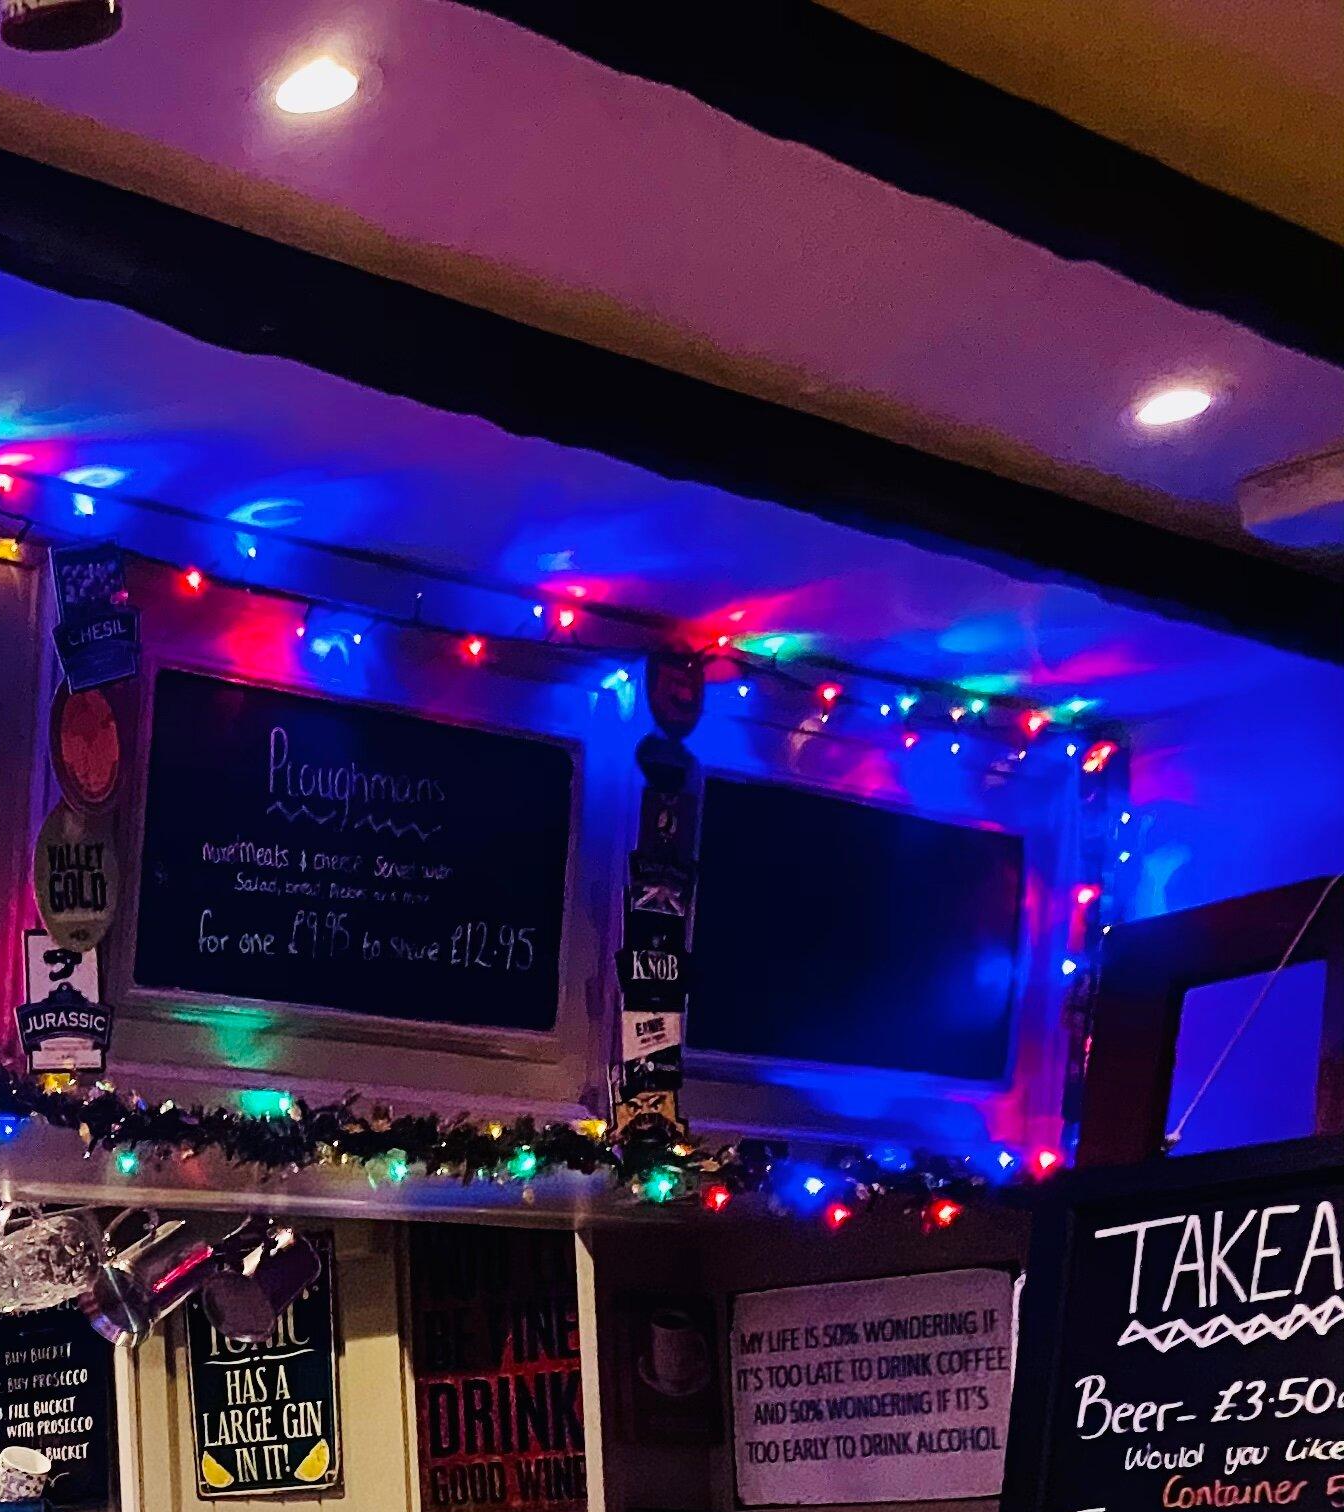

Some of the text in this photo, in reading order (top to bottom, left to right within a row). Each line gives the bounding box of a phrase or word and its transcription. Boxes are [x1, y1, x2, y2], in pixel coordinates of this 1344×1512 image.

[68, 617, 129, 646] CHESIL
[47, 842, 104, 872] VALLEY
[49, 870, 108, 913] GOLD
[238, 920, 537, 971] one to £12.95
[631, 949, 679, 981] KNOB
[24, 1010, 107, 1034] JURASSIC
[740, 1308, 999, 1355] MY LIFE IS 50% WONDERING IF
[5, 1341, 72, 1366] BUY BUCKET
[736, 1345, 1011, 1393] IT'S TOO LATE TO DRINK COFFEE
[7, 1368, 88, 1393] BUY PROSECCO
[225, 1364, 291, 1406] HAS A
[8, 1395, 76, 1421] FILL BUCKET
[427, 1371, 587, 1455] DRINK
[754, 1384, 989, 1426] AND 50% WONDERING IF IT'S
[6, 1416, 94, 1439] WITH PROSECCO
[202, 1400, 323, 1448] LARGE GIN
[45, 1442, 89, 1462] BUCKET
[235, 1443, 291, 1483] IN IT!
[745, 1425, 1004, 1464] TOO EARLY TO DRINK ALCOHOL
[1124, 1442, 1271, 1476] Would you
[429, 1454, 588, 1505] GOOD WINE
[1162, 1473, 1309, 1509] Container
